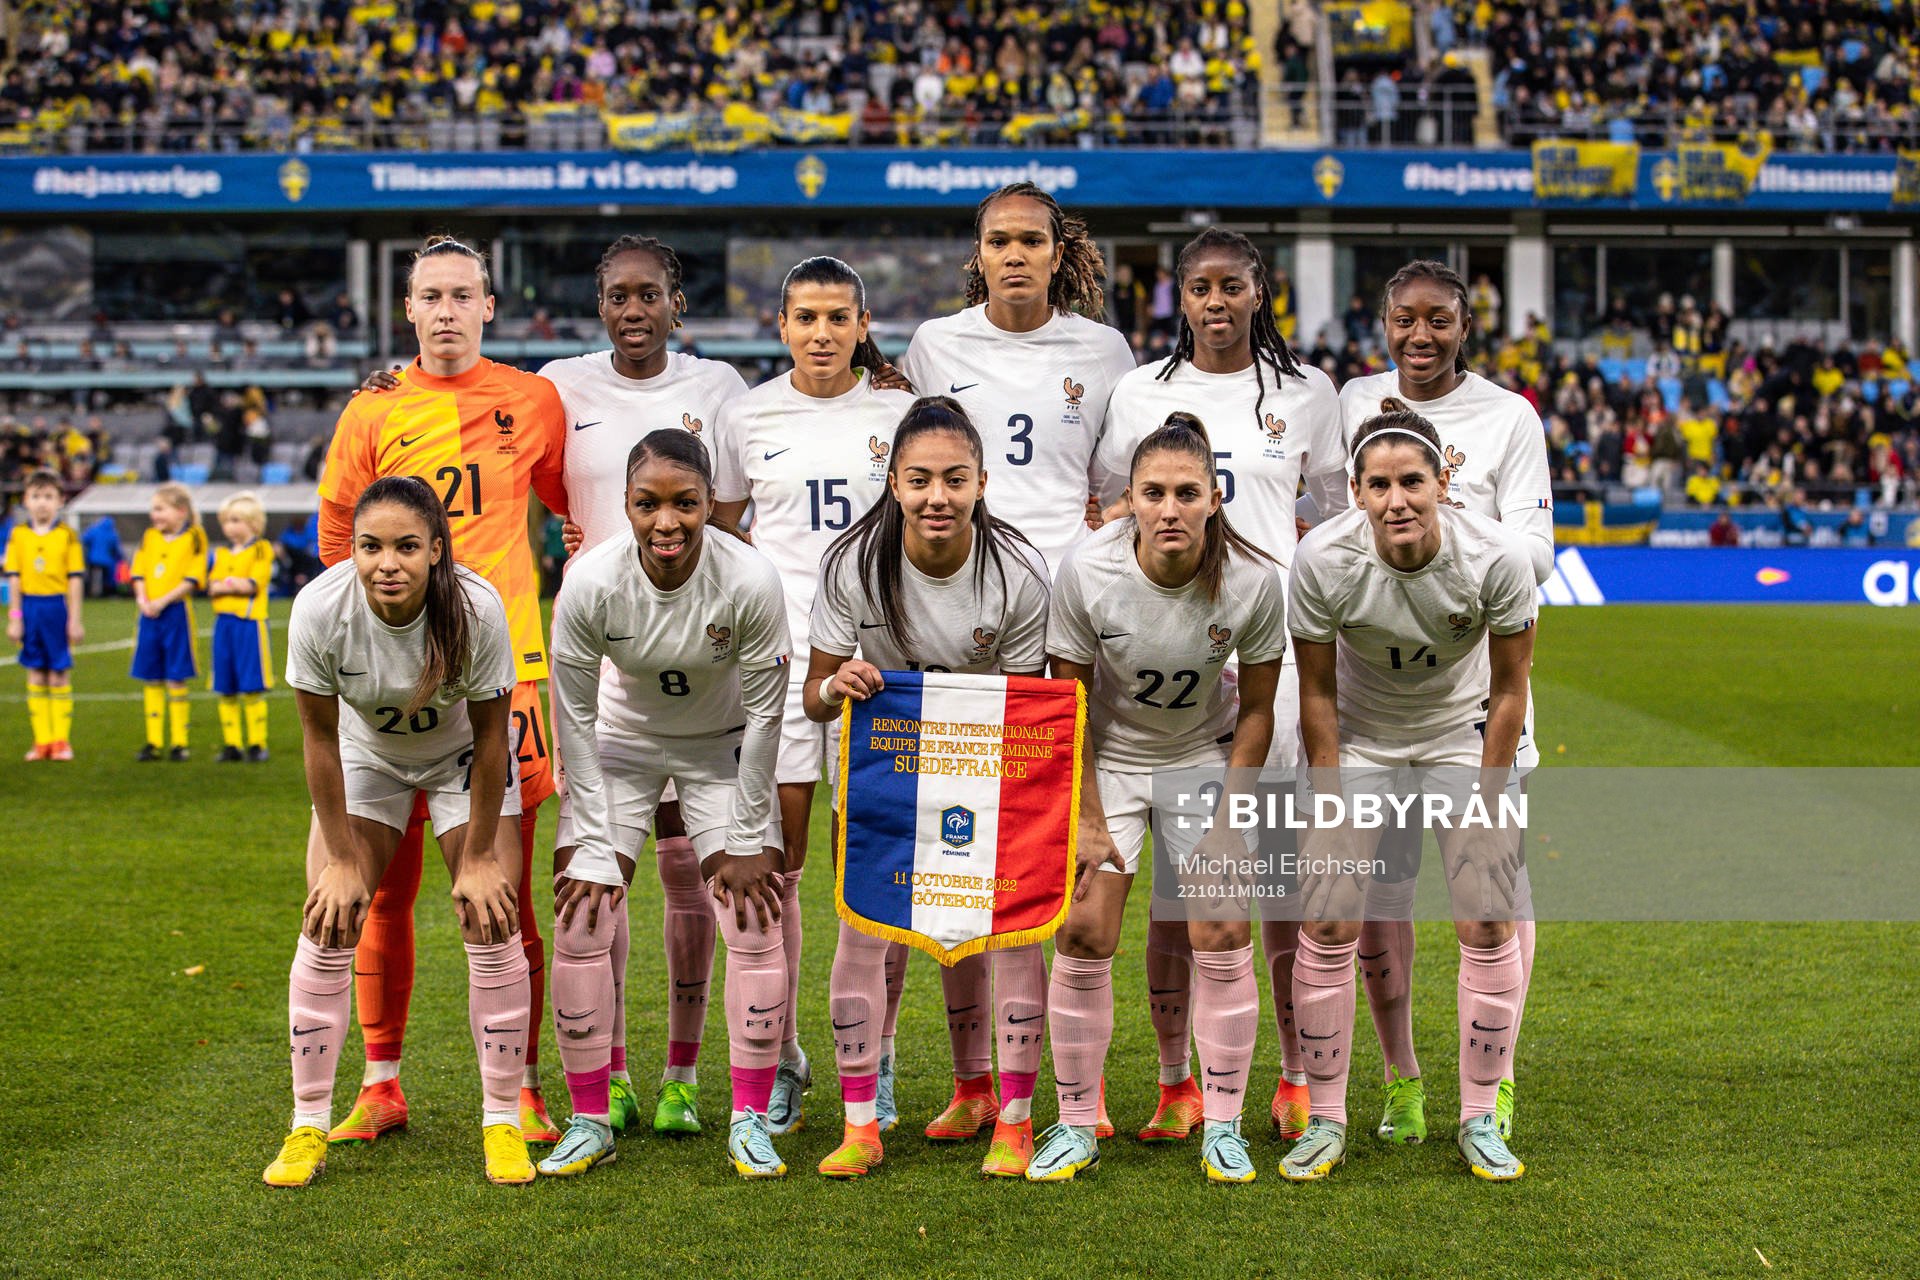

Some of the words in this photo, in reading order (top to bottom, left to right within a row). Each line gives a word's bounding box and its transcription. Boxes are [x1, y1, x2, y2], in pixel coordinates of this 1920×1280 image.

[33, 165, 222, 199] #hejasverige
[623, 161, 738, 194] Sverige
[1006, 413, 1034, 466] 3
[436, 463, 483, 518] 21
[806, 478, 852, 532] 15
[658, 669, 691, 697] 8
[1133, 669, 1201, 710] 22
[375, 706, 439, 736] 20
[871, 717, 948, 736] RENCONTRE
[949, 721, 1055, 741] INTERNATIONALE
[870, 736, 917, 753] EQUIPE
[918, 739, 936, 753] DE
[937, 740, 989, 756] FRANCE
[990, 743, 1053, 759] FEMININE
[894, 755, 1028, 779] SUEDE-FRANCE
[945, 833, 970, 841] FRANCE
[893, 871, 907, 885] 11
[911, 872, 983, 891] OCTOBRE
[985, 877, 1018, 893] 2022
[911, 888, 997, 911] GÖTEBORG
